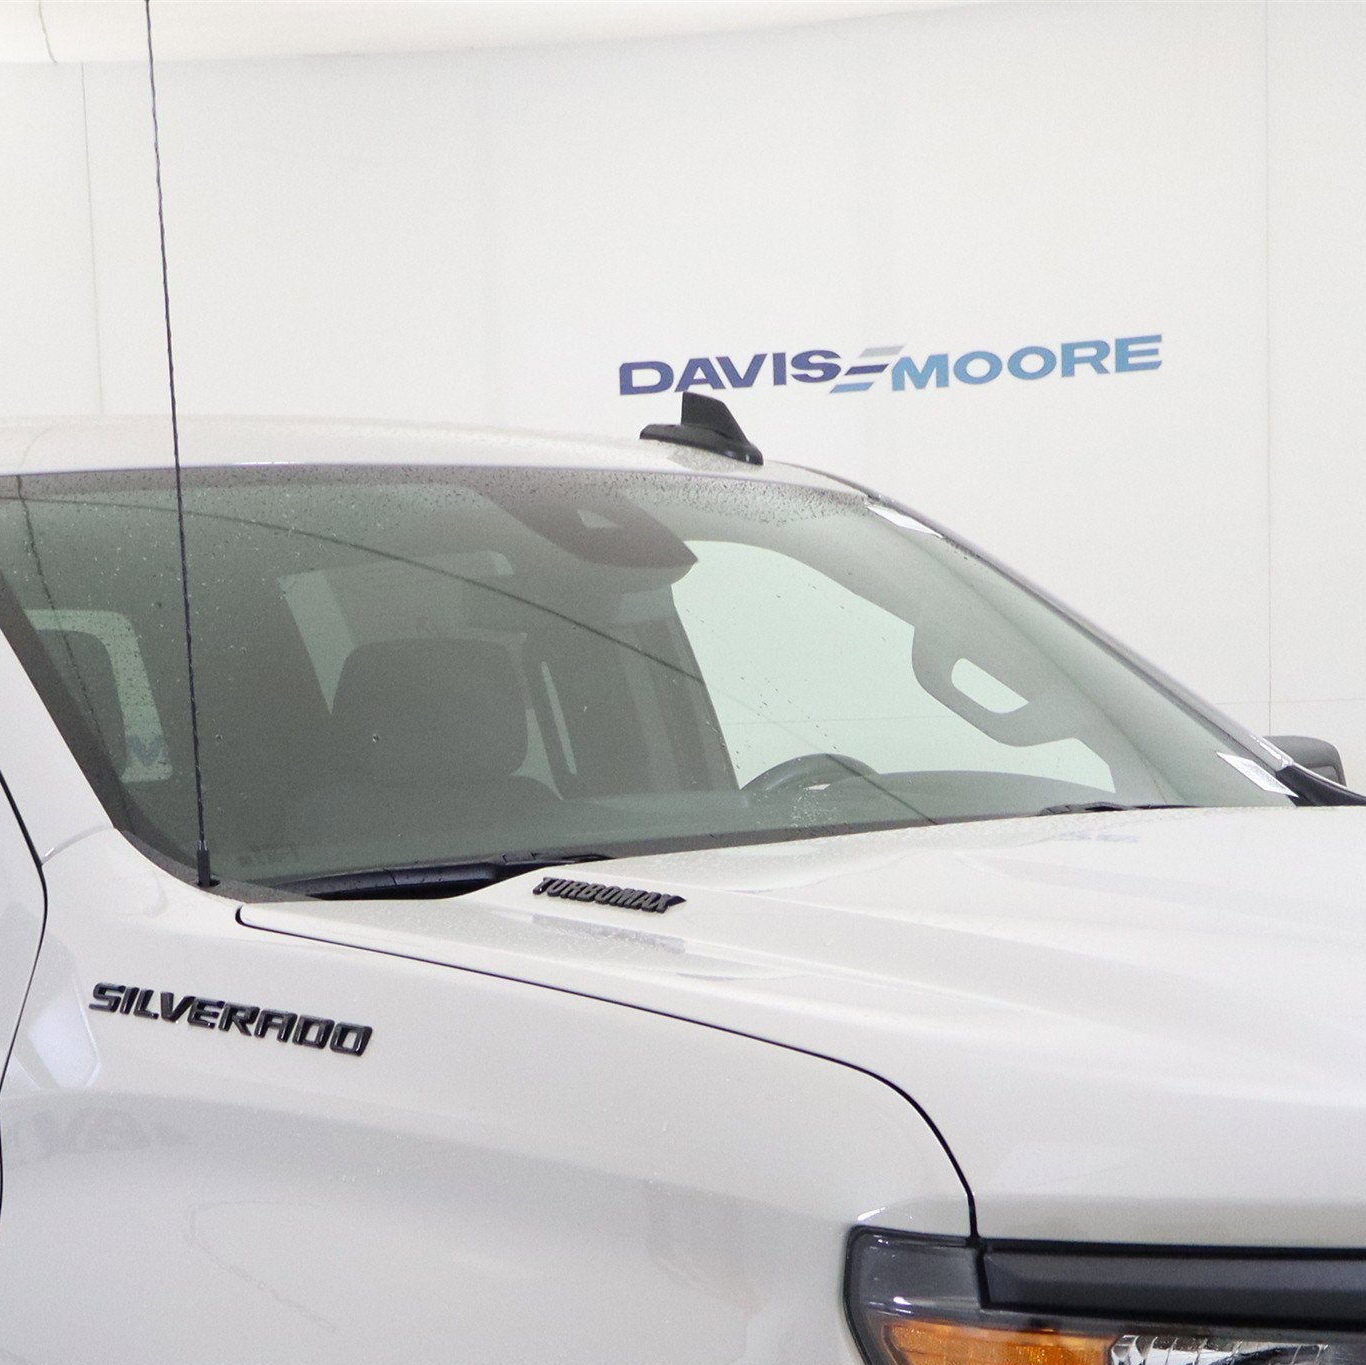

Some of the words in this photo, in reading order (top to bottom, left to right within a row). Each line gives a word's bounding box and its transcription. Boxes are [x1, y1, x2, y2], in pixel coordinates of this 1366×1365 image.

[618, 348, 843, 397] DAVIS
[890, 333, 1163, 392] MOORE
[531, 876, 686, 914] TURBOMAX
[88, 981, 374, 1058] SILVERADO
